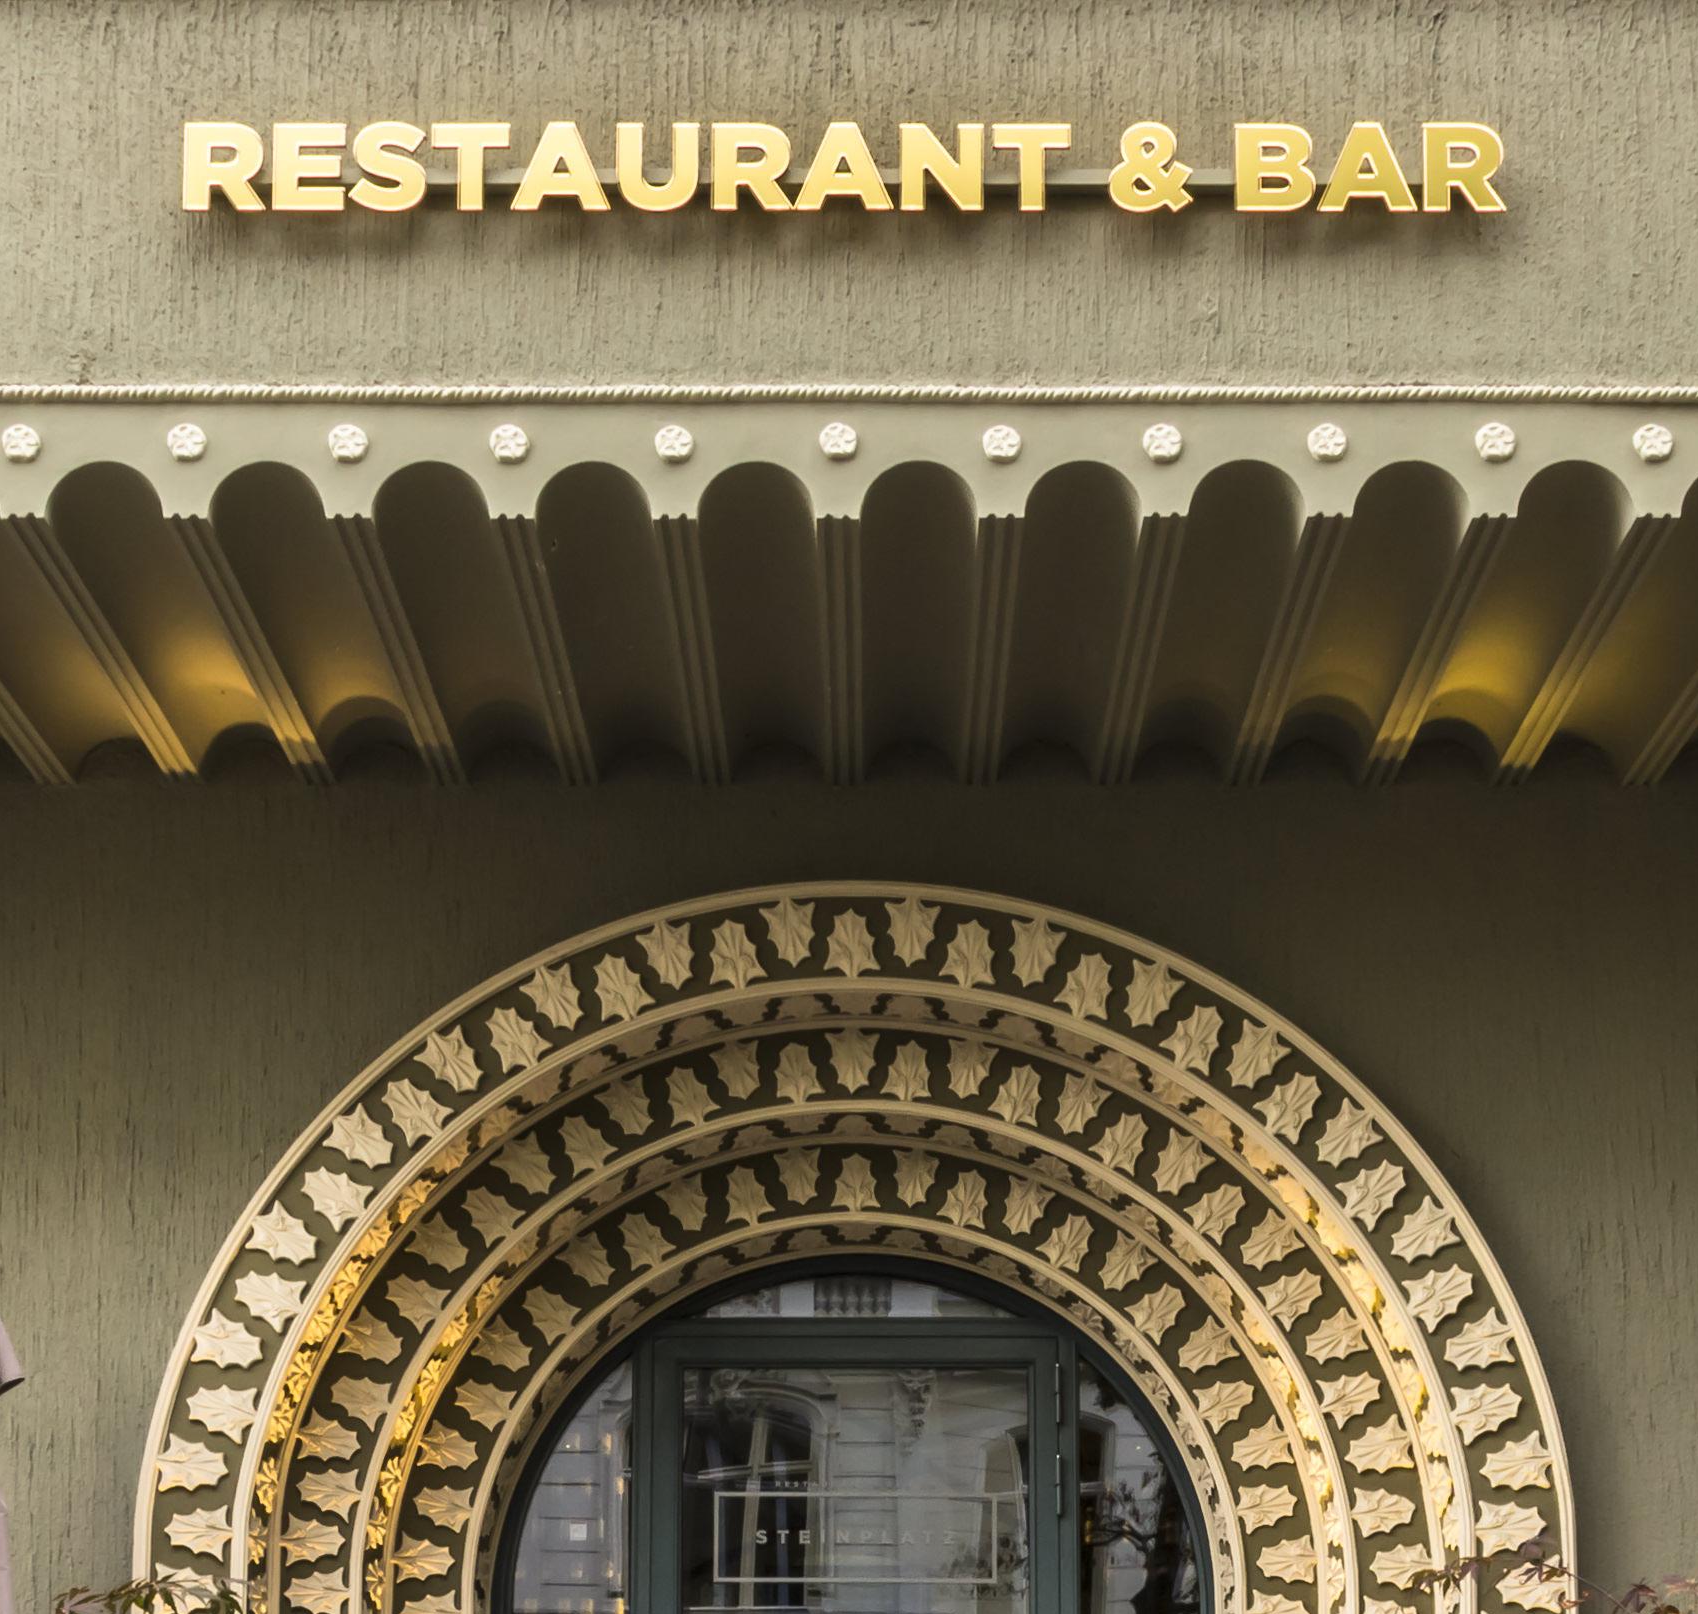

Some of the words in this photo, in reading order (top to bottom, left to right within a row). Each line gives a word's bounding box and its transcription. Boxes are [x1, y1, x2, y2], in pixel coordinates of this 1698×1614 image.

[181, 121, 1073, 213] RESTAURANT
[1106, 120, 1196, 214] &
[1232, 121, 1508, 214] BAR
[755, 1530, 956, 1545] STEINPLATZ
